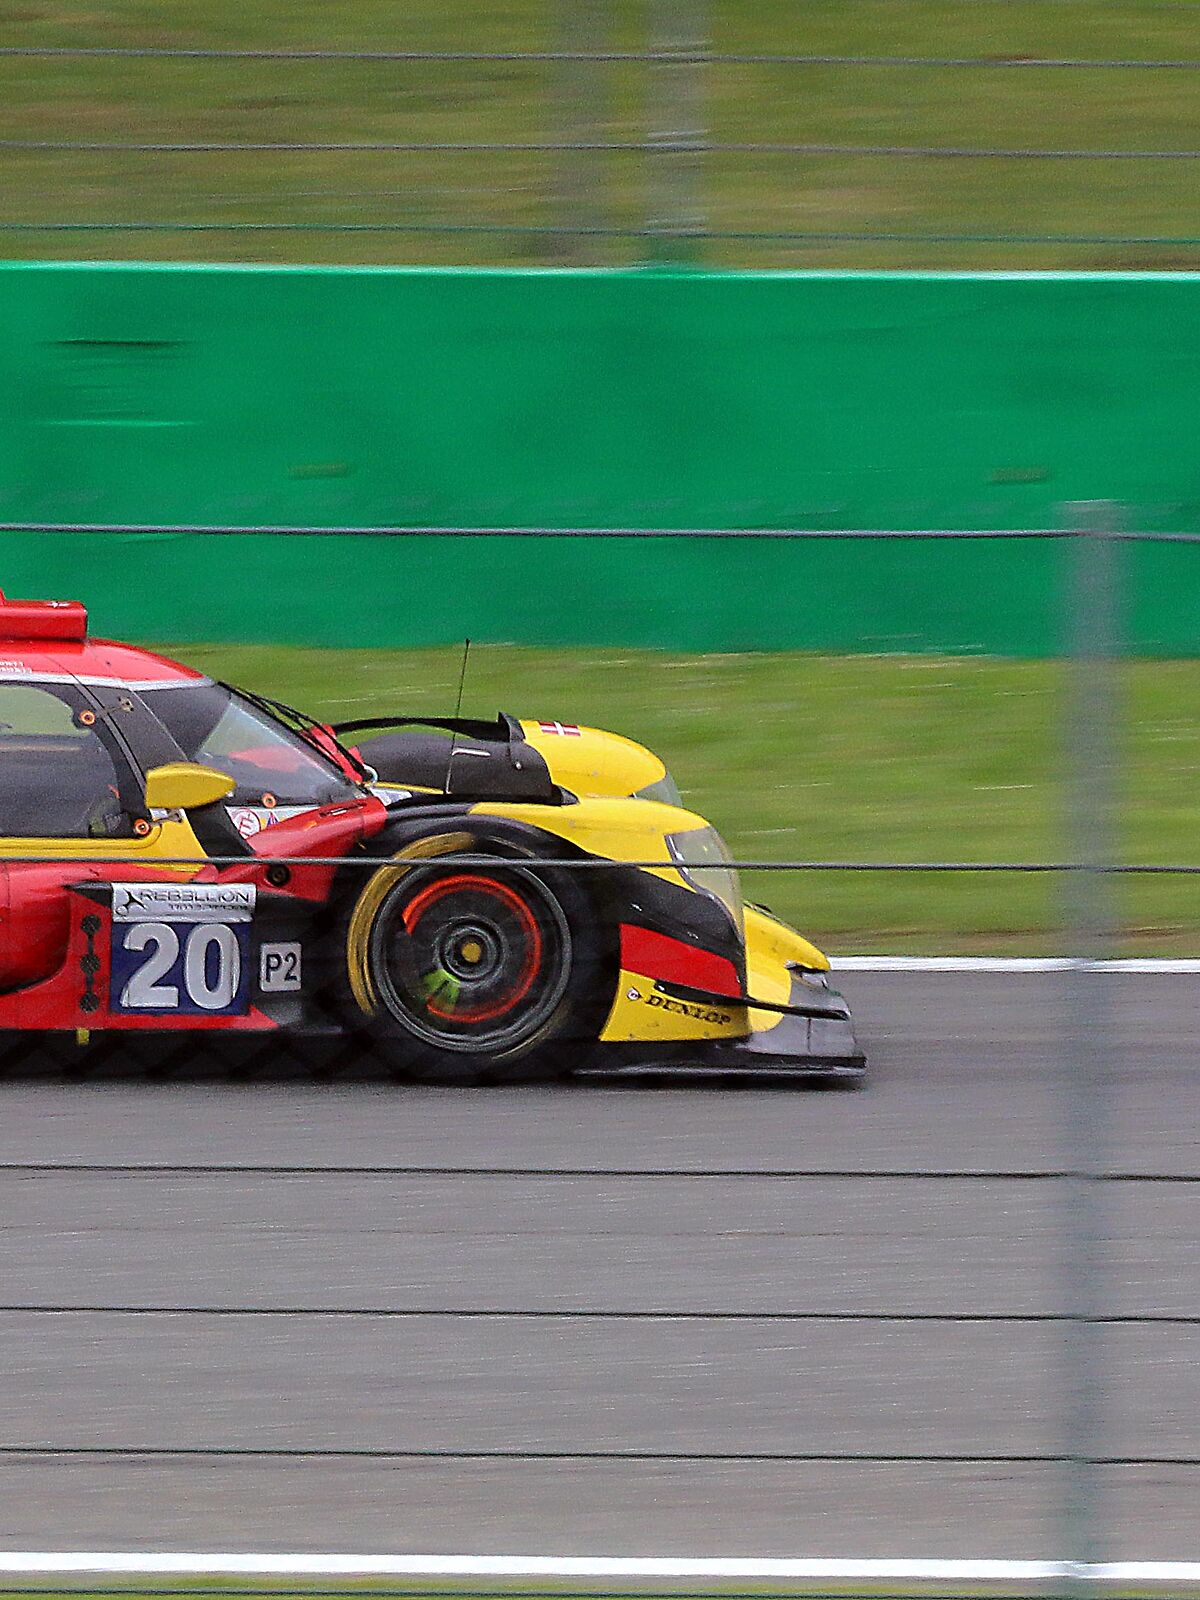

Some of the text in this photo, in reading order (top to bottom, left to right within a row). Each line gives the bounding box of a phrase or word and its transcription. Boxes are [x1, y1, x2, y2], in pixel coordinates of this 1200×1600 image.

[120, 921, 240, 1010] 20
[266, 952, 298, 983] P2
[644, 994, 732, 1026] DUNLOP
